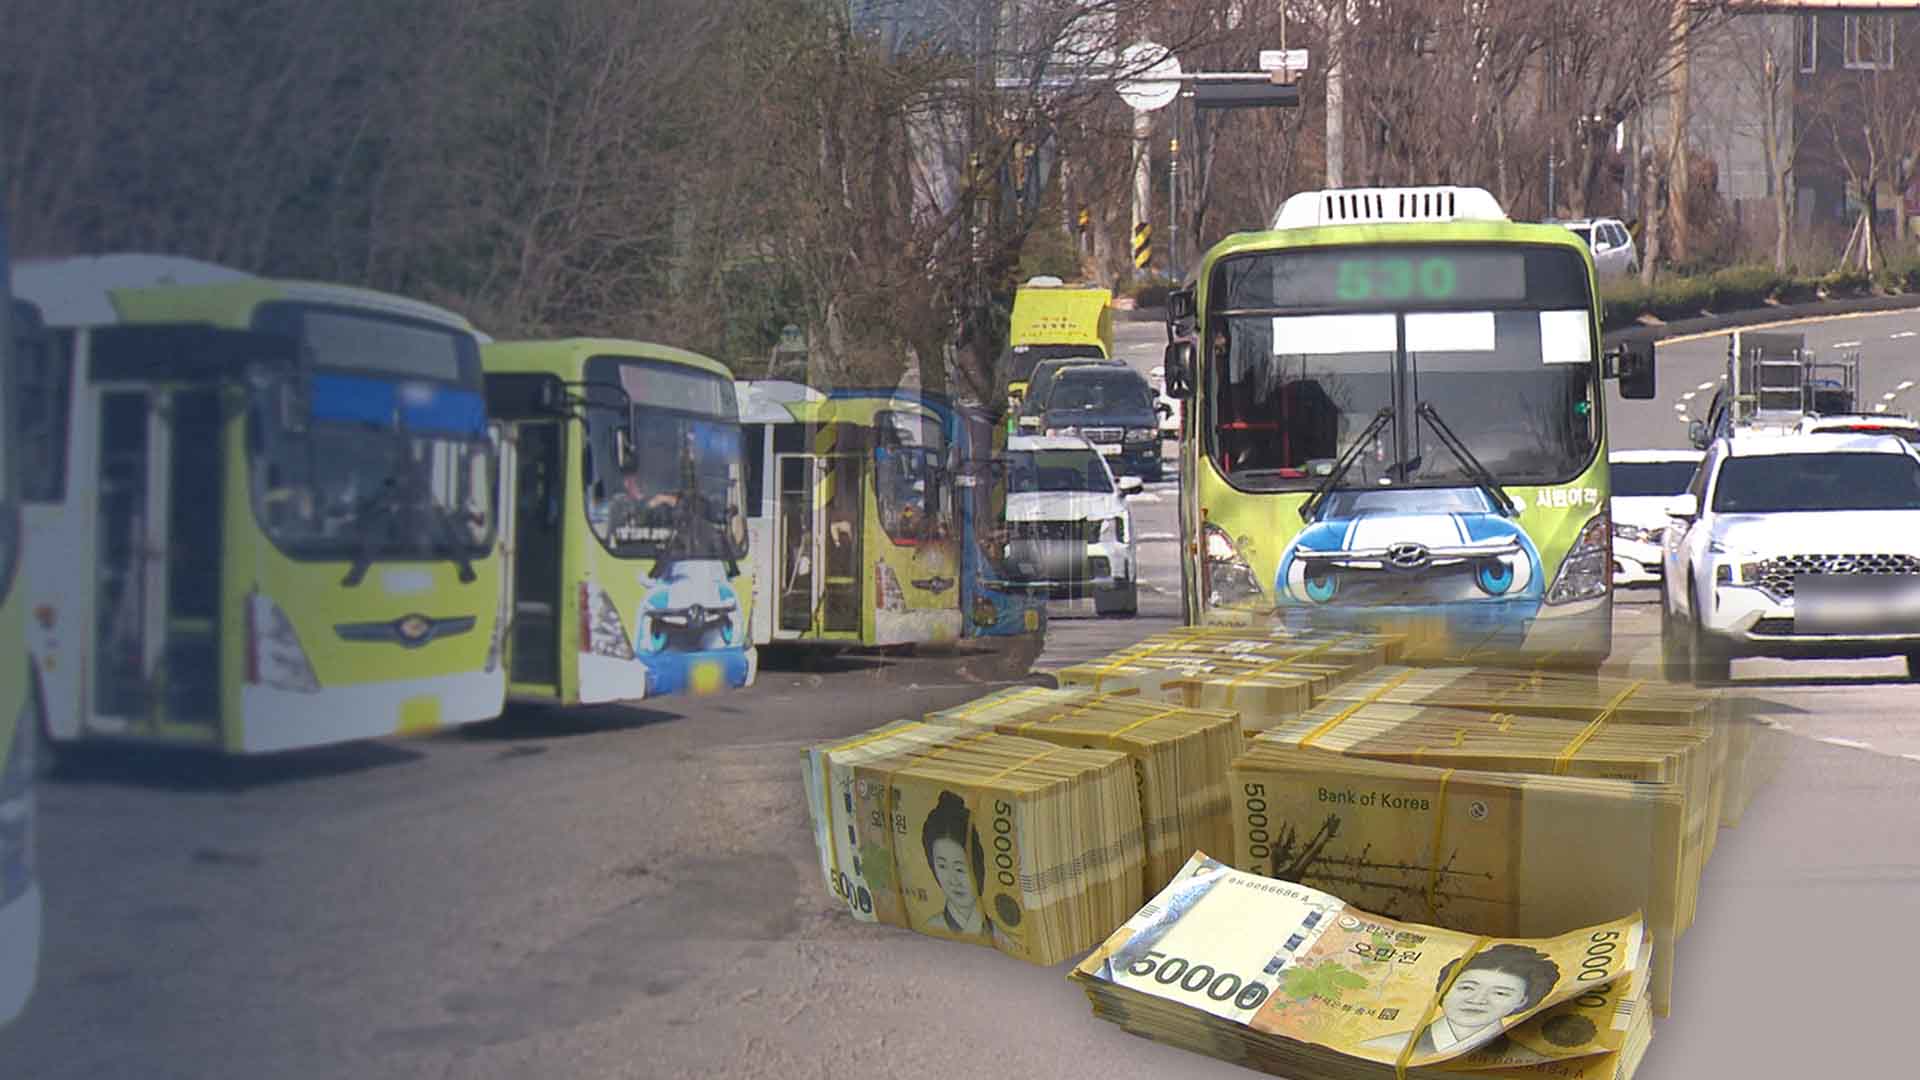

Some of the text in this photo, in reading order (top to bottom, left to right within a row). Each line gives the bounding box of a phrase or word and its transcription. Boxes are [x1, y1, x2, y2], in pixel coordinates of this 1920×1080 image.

[1336, 256, 1456, 300] 530
[1244, 783, 1269, 859] 50000
[1318, 787, 1430, 811] Bank of Korea
[994, 800, 1015, 887] 50000
[1128, 951, 1269, 1010] 50000
